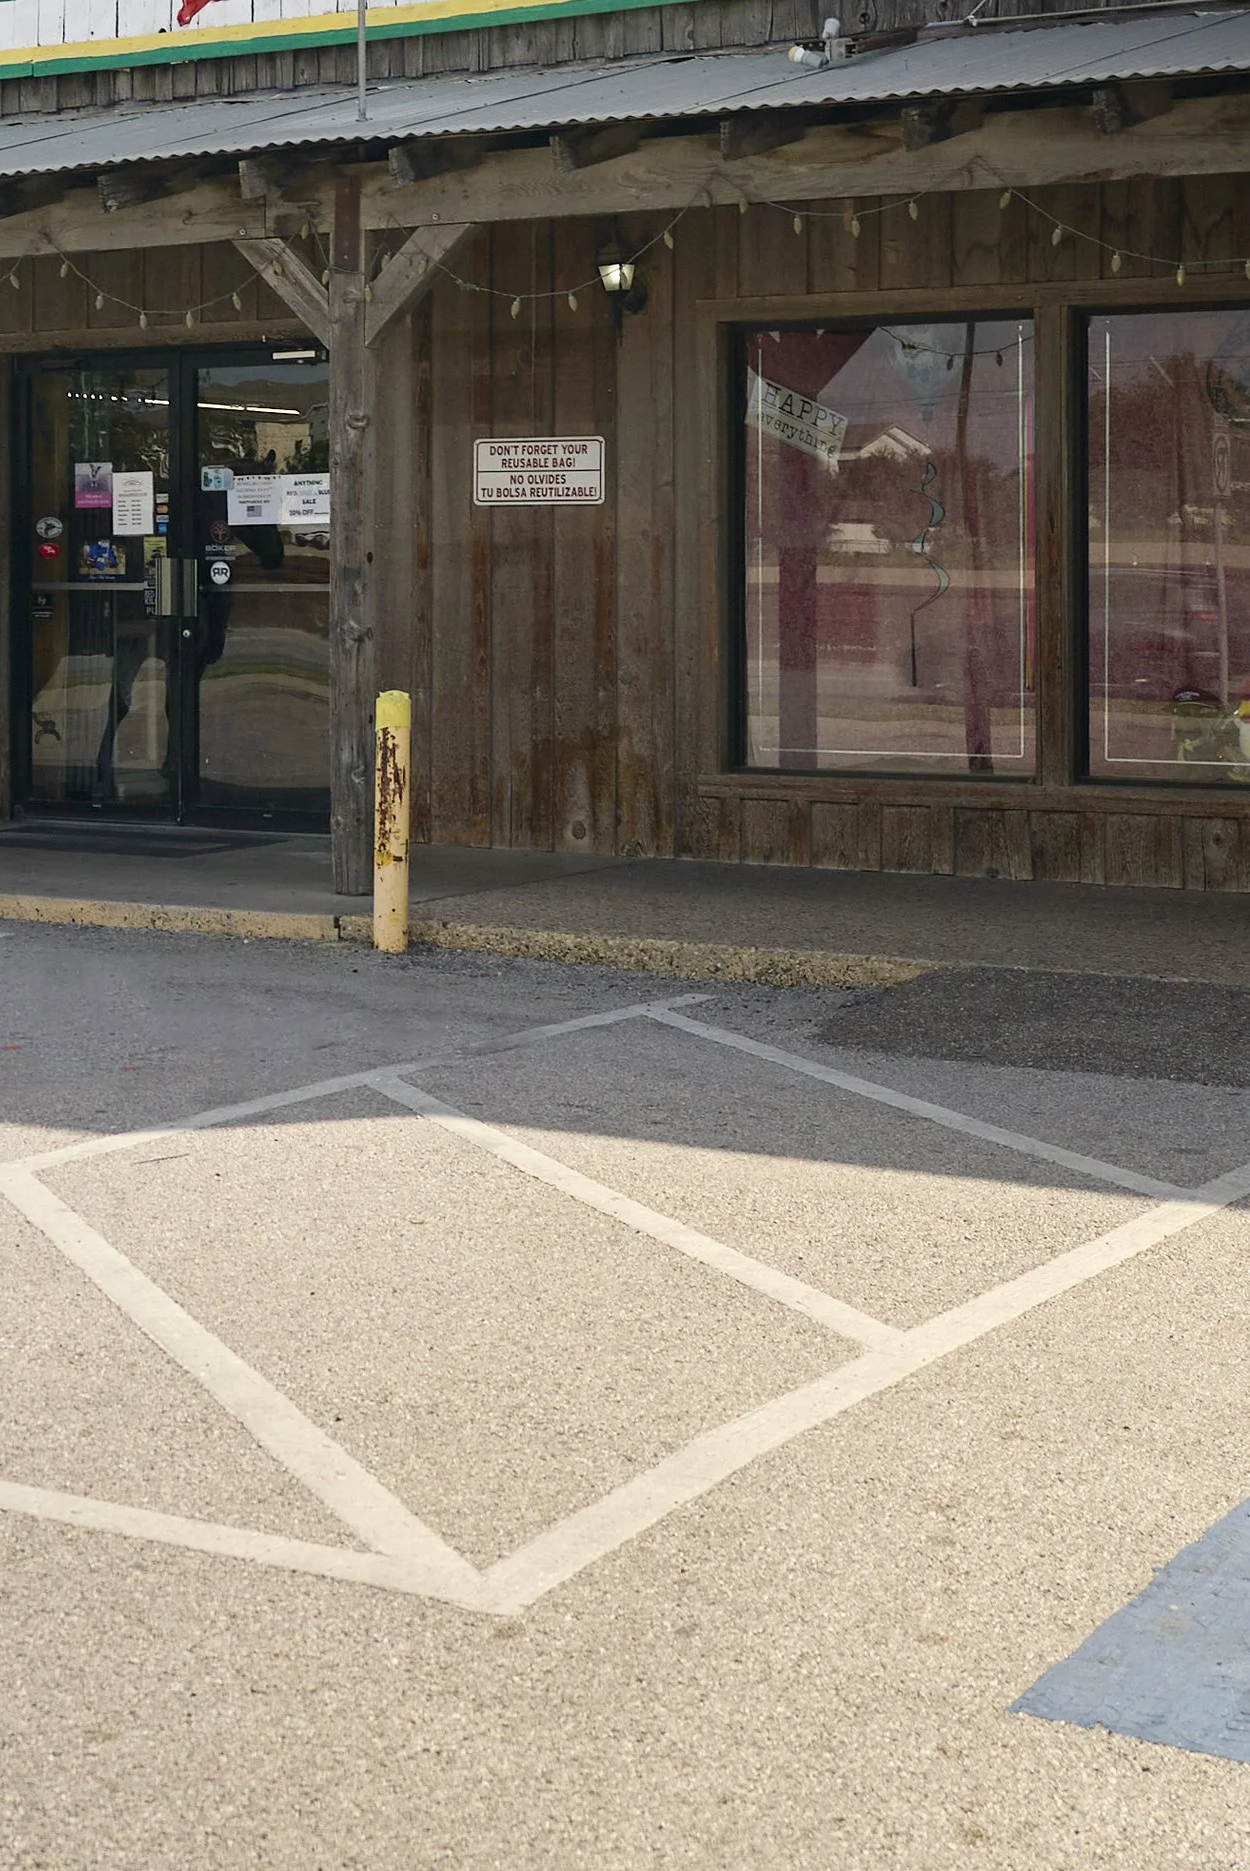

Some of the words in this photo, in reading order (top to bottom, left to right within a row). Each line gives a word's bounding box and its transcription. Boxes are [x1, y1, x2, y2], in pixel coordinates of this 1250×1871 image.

[761, 382, 845, 436] HAPPY
[756, 412, 837, 458] everything
[489, 445, 519, 456] DON'T
[521, 444, 558, 455] FORGET
[561, 444, 588, 455] YOUR
[501, 458, 549, 468] REUSABLE
[552, 457, 576, 468] BAG!
[509, 474, 524, 485] NO
[527, 474, 566, 485] OLVIDES
[480, 487, 493, 498] TU
[496, 487, 527, 498] BOLSA
[529, 486, 597, 498] REUTILIZABLE!
